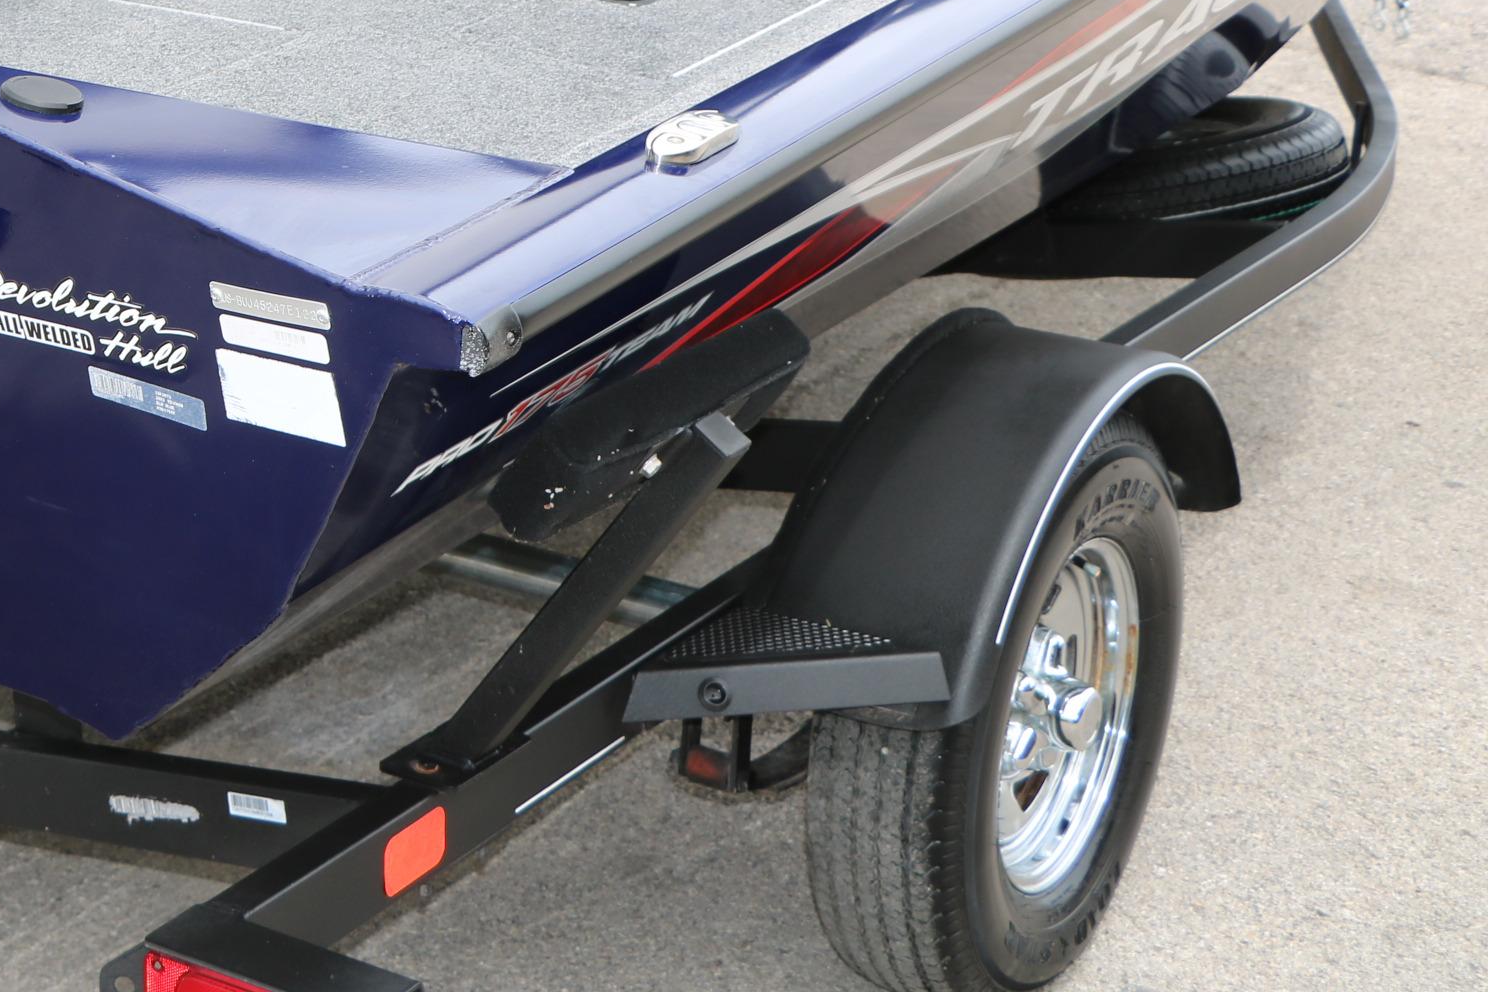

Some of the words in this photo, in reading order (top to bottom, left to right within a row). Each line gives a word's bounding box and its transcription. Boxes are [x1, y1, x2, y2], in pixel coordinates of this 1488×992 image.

[24, 321, 93, 352] WELDED
[98, 330, 188, 375] Hull
[390, 417, 505, 498] PRO
[600, 293, 713, 374] TEAM
